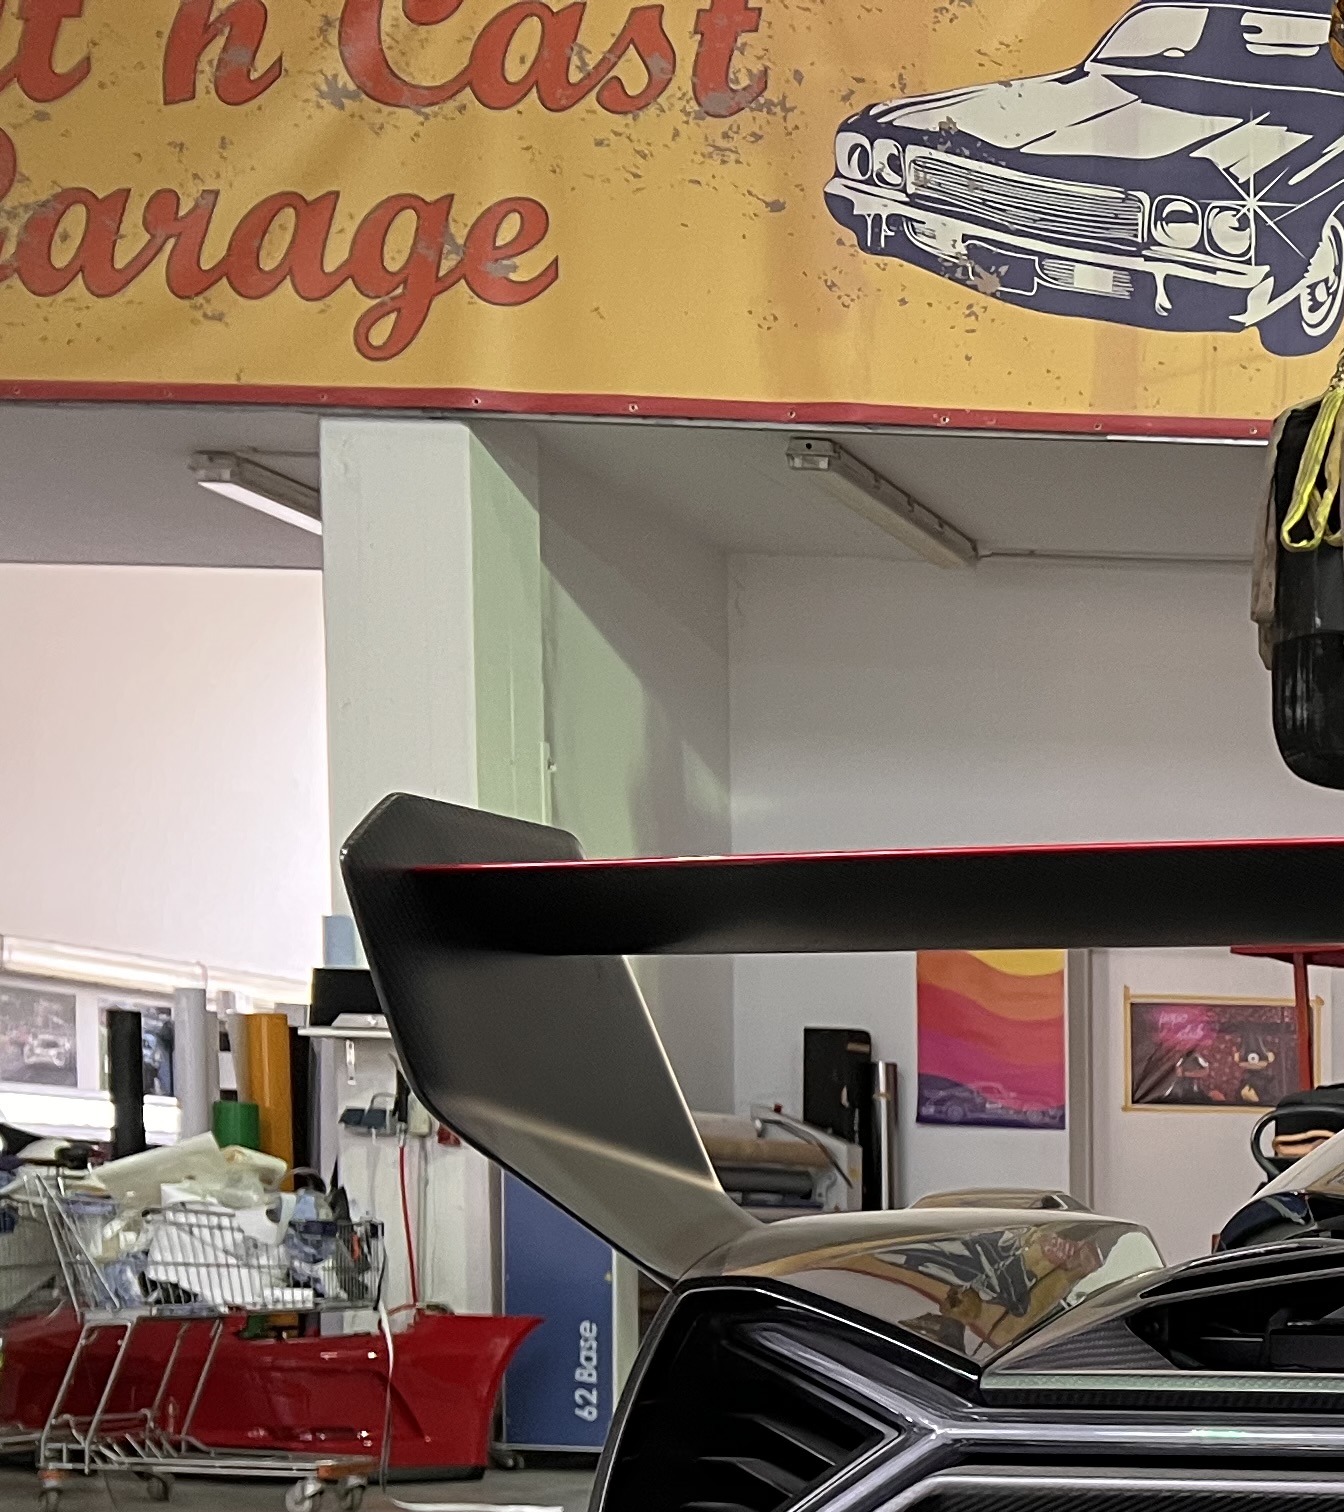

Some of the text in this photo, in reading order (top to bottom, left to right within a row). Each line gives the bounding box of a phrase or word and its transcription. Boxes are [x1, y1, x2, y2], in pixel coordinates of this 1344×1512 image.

[338, 0, 768, 118] Cast
[0, 126, 560, 362] arage
[574, 1319, 598, 1422] 62 Base
